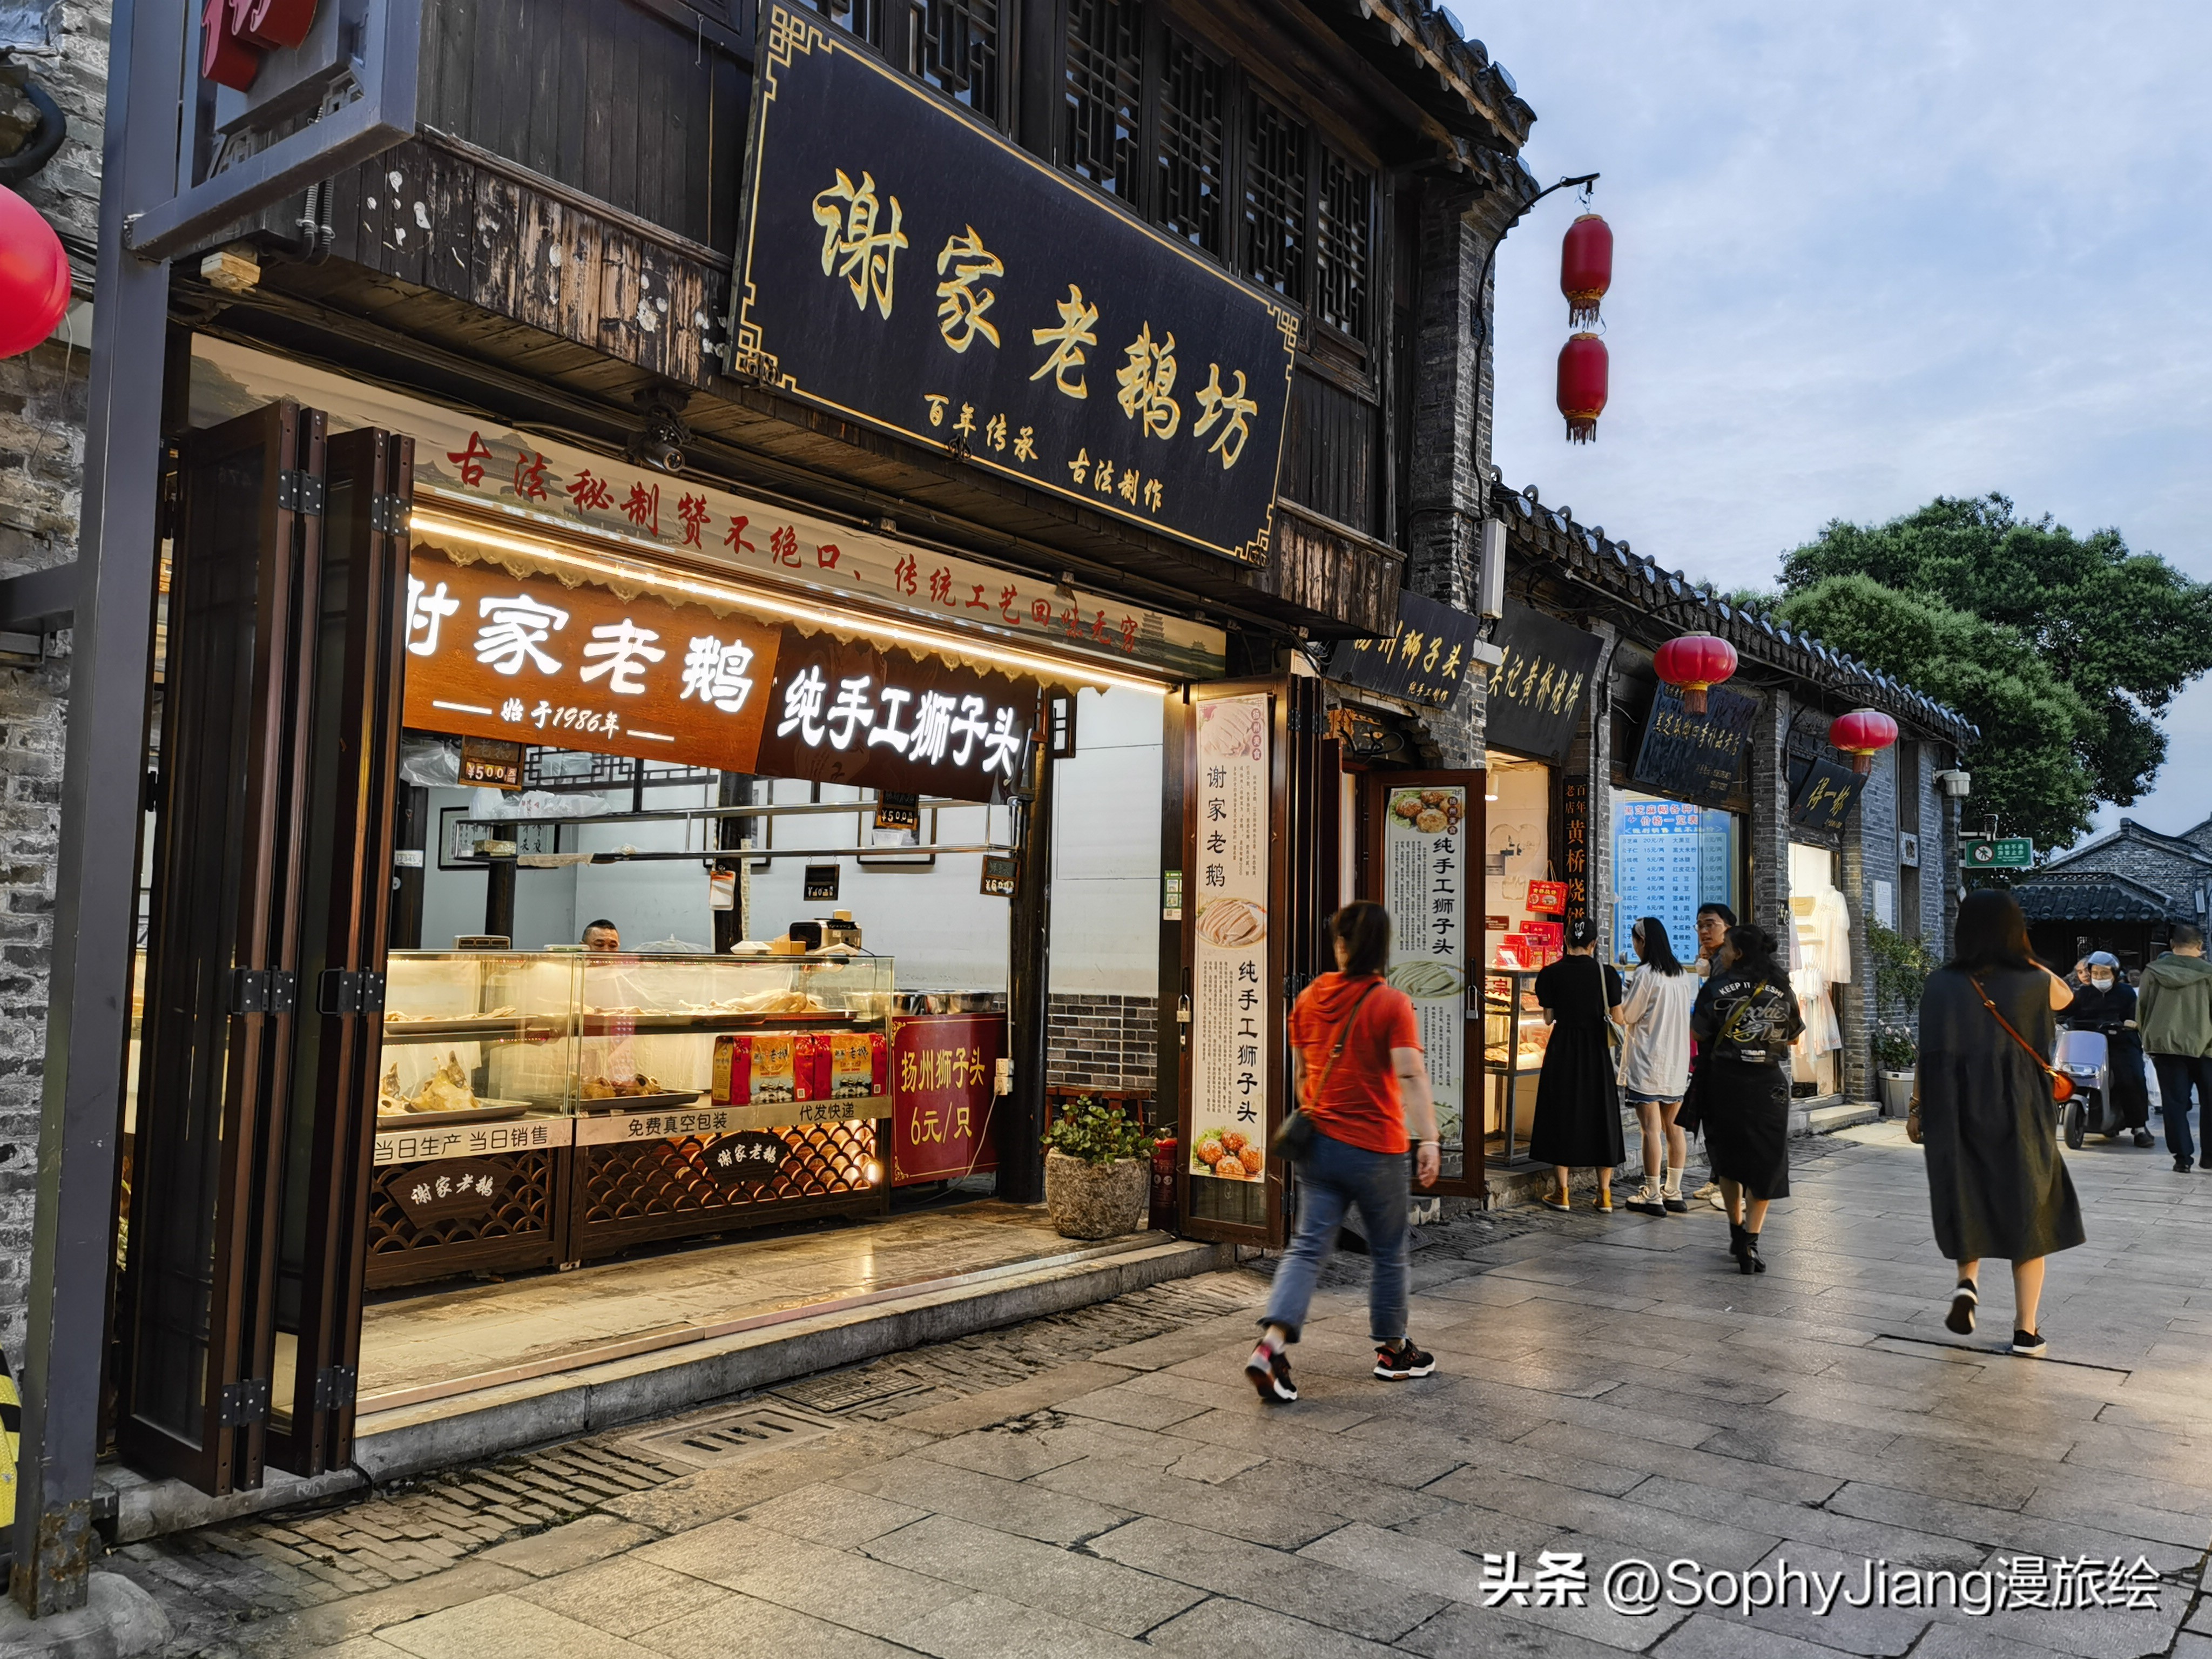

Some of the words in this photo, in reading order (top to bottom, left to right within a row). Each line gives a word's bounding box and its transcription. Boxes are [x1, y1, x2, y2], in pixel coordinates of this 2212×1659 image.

[812, 167, 1258, 470] 谢家老鹅坊
[923, 393, 1038, 463] 百年传承
[1068, 447, 1164, 514] 古法制作
[777, 664, 1021, 777] 纯手工狮子头
[1205, 765, 1227, 887] 谢家老鹅
[1448, 798, 1458, 834] 扬州美食
[1432, 837, 1455, 955] 纯手工狮子头
[1718, 982, 1741, 996] KEEP
[1743, 981, 1751, 989] IT
[1237, 960, 1259, 1124] 纯手工狮子头
[900, 1046, 986, 1093] 扬州狮子头
[628, 1111, 728, 1137] 免费真空包装
[800, 1102, 855, 1122] 代发快递
[911, 1101, 973, 1146] 6元/只
[375, 1133, 462, 1162] 当日生产
[469, 1125, 549, 1152] 当日销售
[717, 1142, 778, 1169] 谢家老鹅
[410, 1173, 494, 1205] 谢家老鹅
